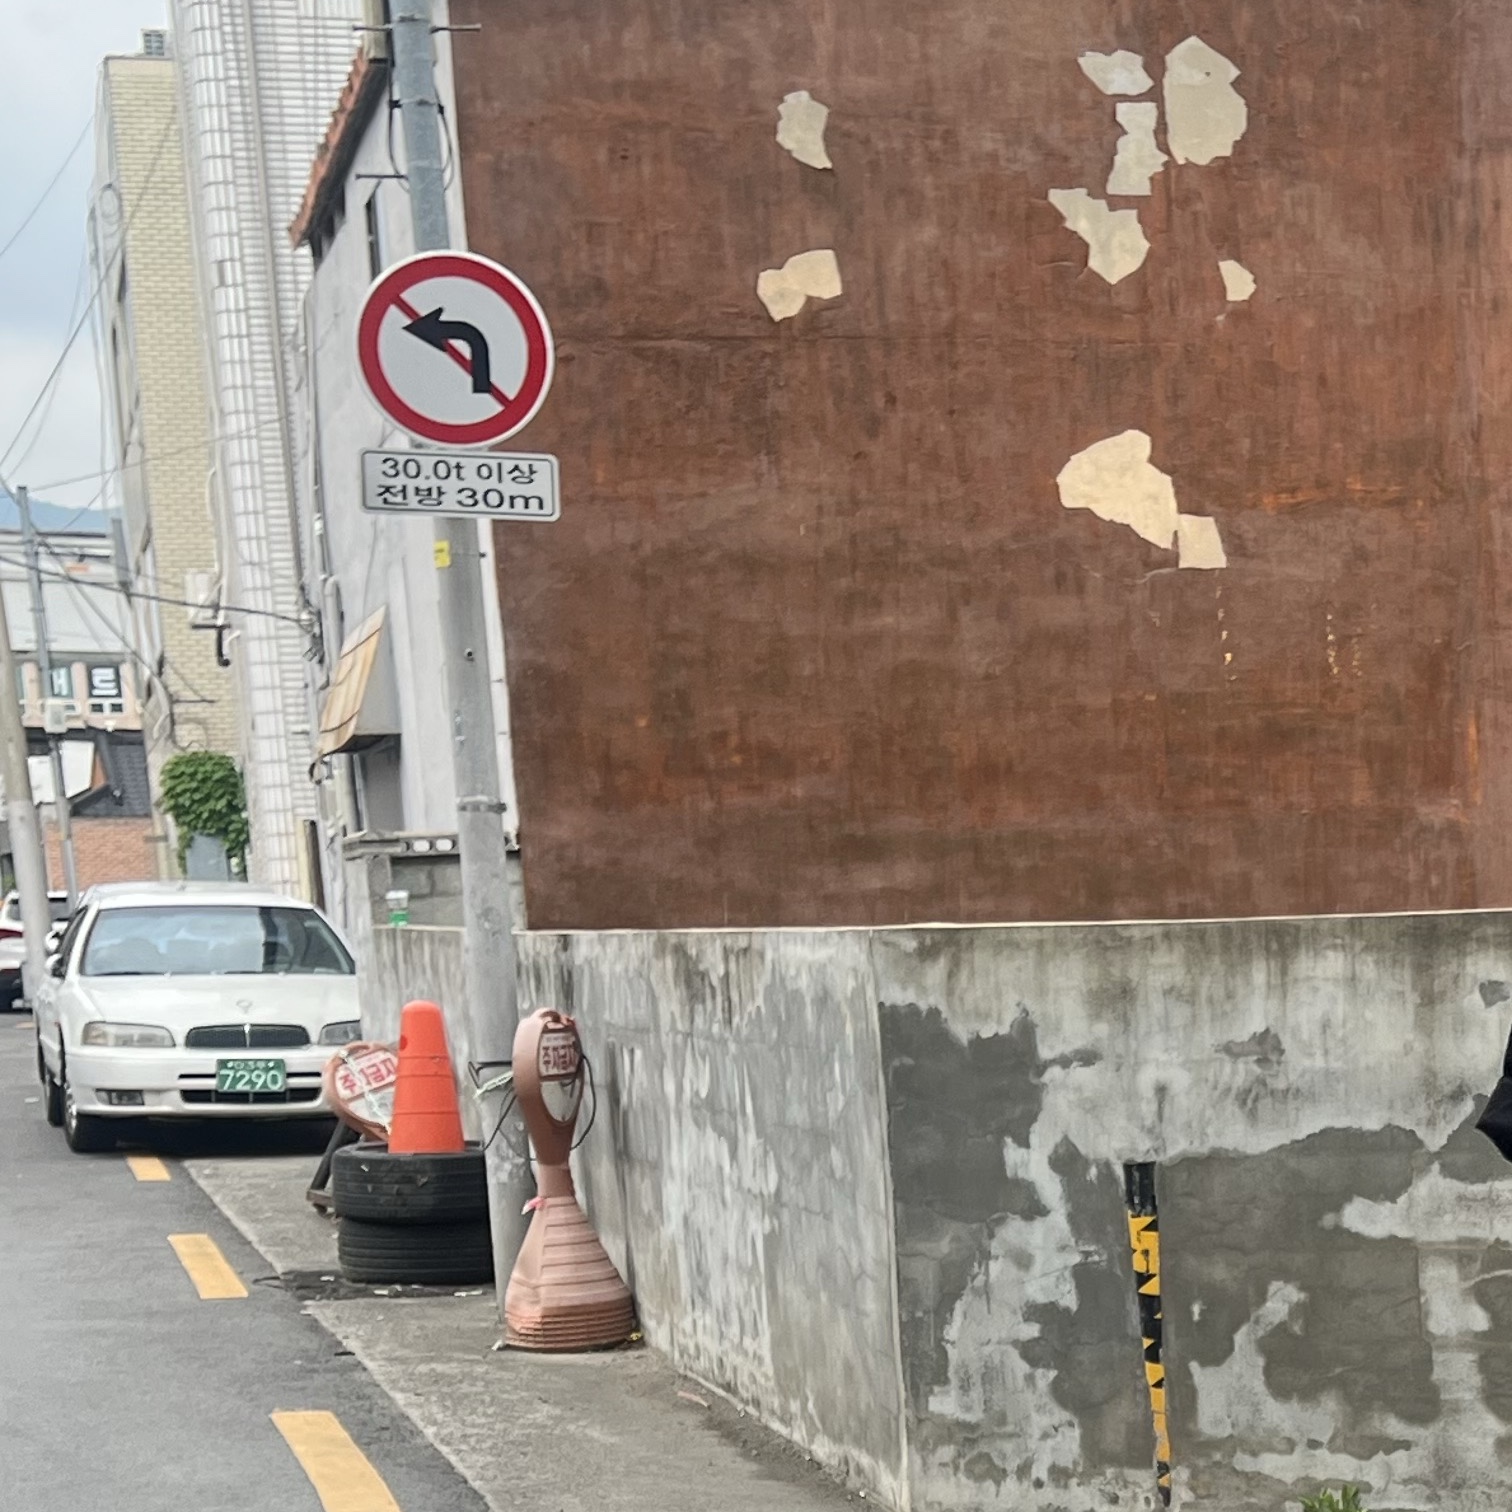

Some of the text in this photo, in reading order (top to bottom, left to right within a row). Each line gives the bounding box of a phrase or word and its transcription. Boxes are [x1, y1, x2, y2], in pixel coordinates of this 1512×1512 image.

[381, 457, 538, 484] 30.0t 이상
[376, 484, 544, 511] 전방 30m
[219, 1069, 282, 1091] 7290
